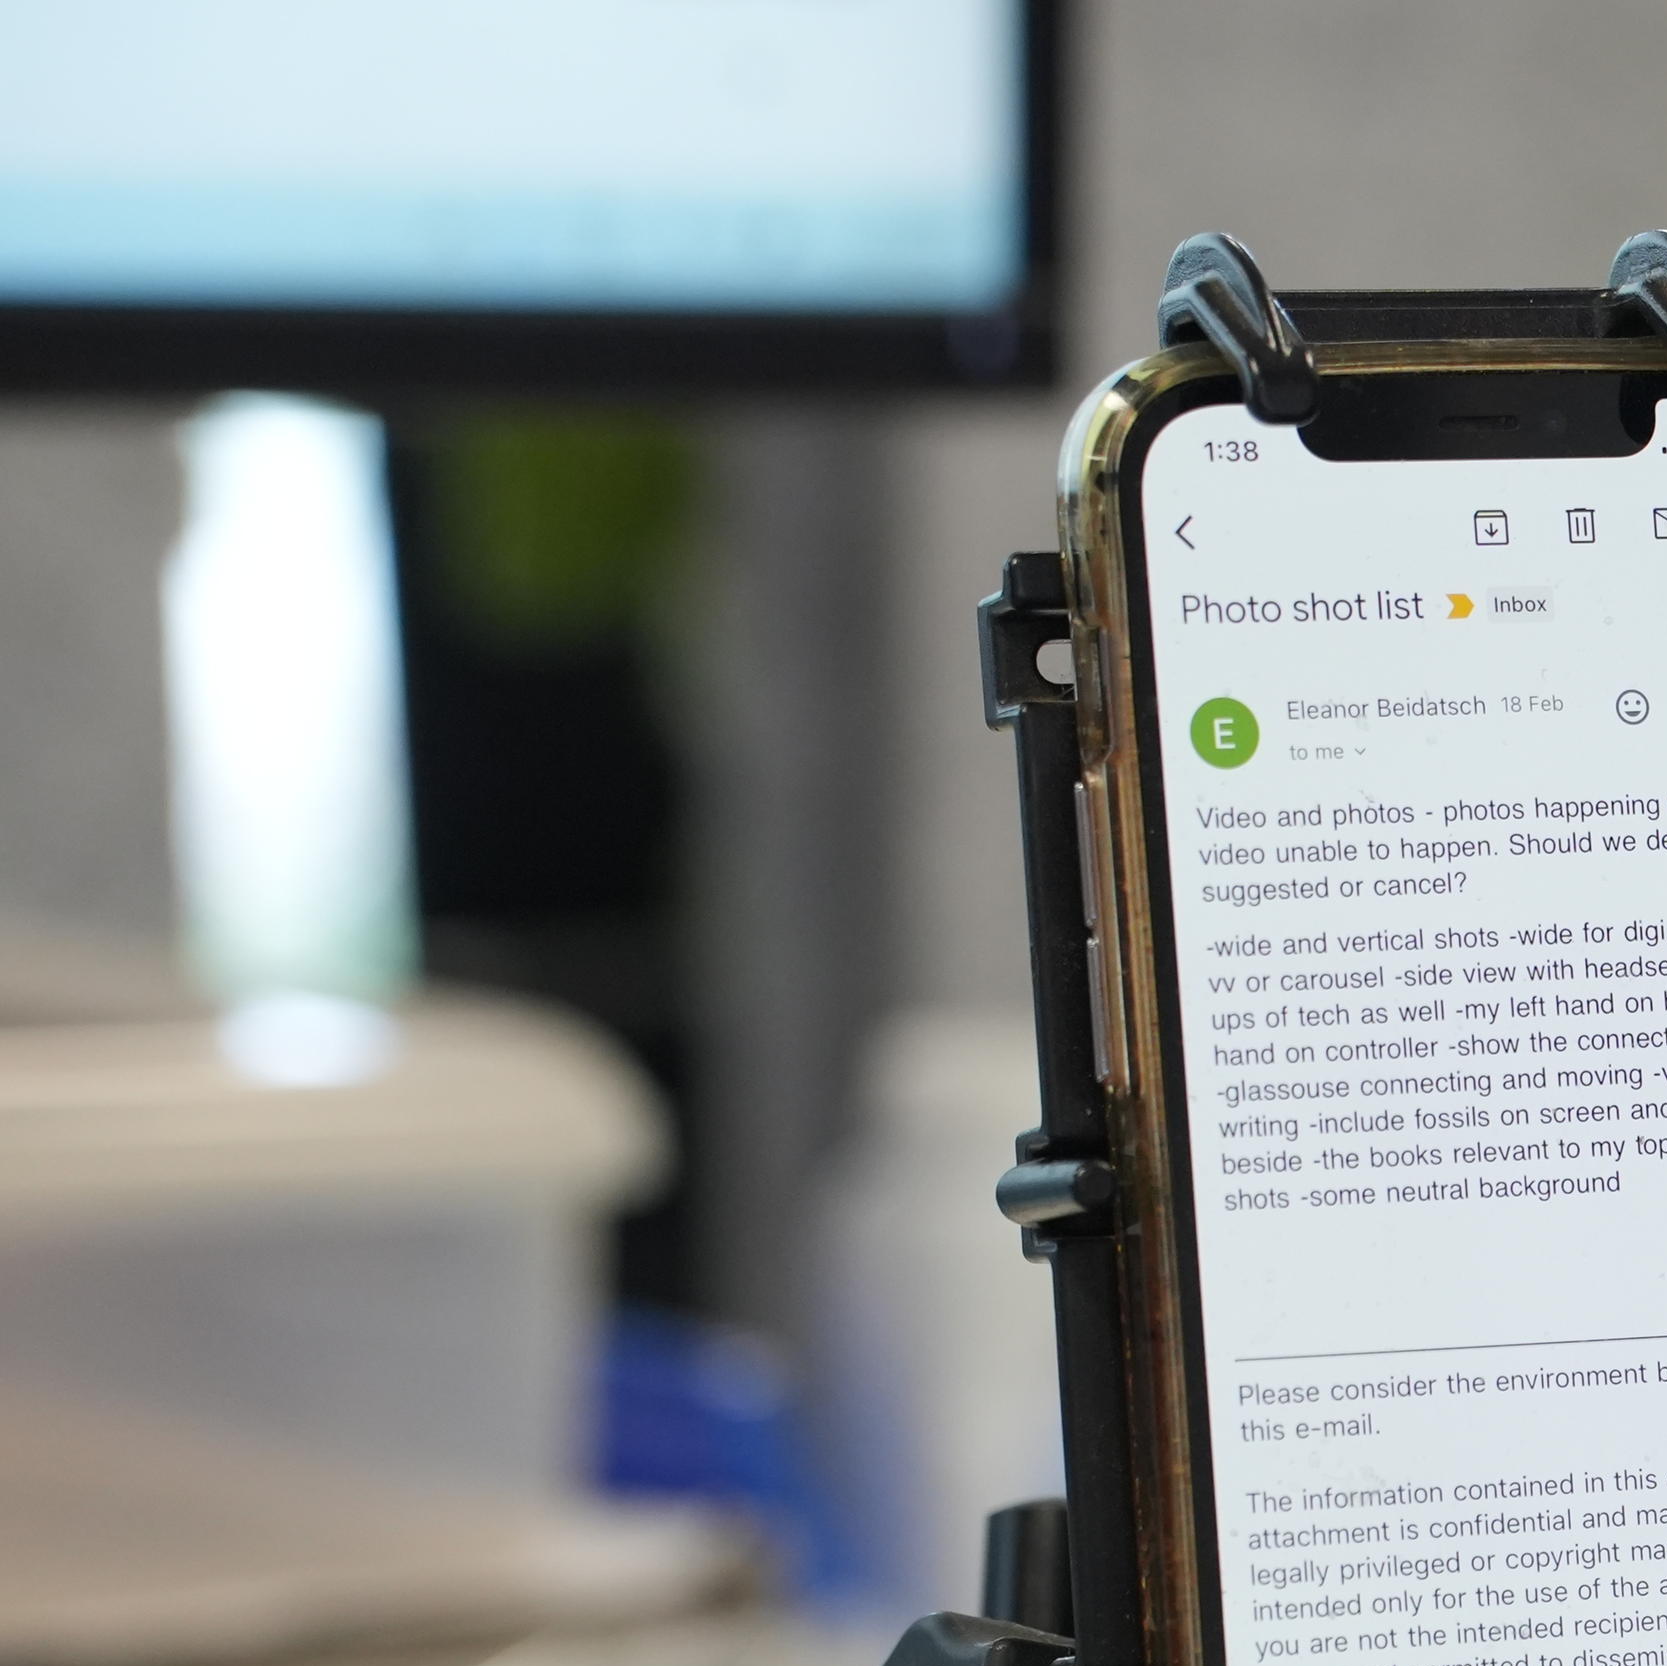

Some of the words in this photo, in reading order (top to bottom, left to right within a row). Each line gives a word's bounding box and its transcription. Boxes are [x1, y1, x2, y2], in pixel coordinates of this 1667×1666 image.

[1203, 440, 1259, 463] 1:38
[1181, 593, 1282, 625] Photo
[1292, 591, 1368, 623] shot
[1376, 589, 1425, 621] list
[1493, 595, 1548, 614] Inbox
[1286, 699, 1370, 721] Eleanor
[1376, 695, 1487, 718] Beidatsch
[1500, 695, 1523, 713] 18
[1528, 694, 1564, 712] Feb
[1212, 717, 1237, 750] E
[1289, 745, 1309, 761] to
[1315, 746, 1344, 760] me
[1195, 806, 1267, 830] Video
[1277, 803, 1323, 828] and
[1332, 800, 1415, 832] photos
[1443, 799, 1525, 828] photos
[1534, 793, 1661, 824] happening
[1198, 842, 1266, 866] video
[1275, 839, 1358, 864] unable
[1366, 839, 1391, 861] to
[1400, 837, 1499, 865] happen.
[1508, 830, 1593, 856] Should
[1601, 834, 1637, 852] we
[1201, 875, 1330, 908] suggested
[1339, 880, 1364, 898] or
[1372, 871, 1468, 897] cancel?
[1206, 933, 1272, 958] -wide
[1282, 931, 1328, 956] and
[1336, 927, 1424, 953] vertical
[1434, 926, 1500, 950] shots
[1508, 922, 1574, 946] -wide
[1581, 921, 1615, 944] for
[1207, 976, 1236, 994] vv
[1245, 975, 1271, 993] or
[1279, 965, 1384, 992] carousel
[1394, 963, 1453, 987] -side
[1461, 961, 1517, 984] view
[1525, 958, 1575, 982] with
[1211, 1012, 1256, 1036] ups
[1265, 1005, 1288, 1029] of
[1297, 1002, 1350, 1027] tech
[1360, 1006, 1389, 1025] as
[1397, 999, 1445, 1023] well
[1455, 1002, 1501, 1026] -my
[1509, 994, 1547, 1019] left
[1555, 991, 1615, 1017] hand
[1624, 995, 1654, 1014] on
[1213, 1041, 1275, 1067] hand
[1284, 1045, 1315, 1064] on
[1325, 1036, 1439, 1063] controller
[1448, 1033, 1520, 1057] -show
[1528, 1030, 1568, 1054] the
[1216, 1079, 1350, 1109] -glassouse
[1359, 1069, 1492, 1098] connecting
[1502, 1066, 1547, 1091] and
[1557, 1063, 1643, 1091] moving
[1218, 1114, 1299, 1143] writing
[1309, 1109, 1405, 1135] -include
[1413, 1105, 1491, 1130] fossils
[1499, 1108, 1530, 1127] on
[1539, 1104, 1621, 1125] screen
[1221, 1149, 1303, 1176] beside
[1313, 1147, 1360, 1171] -the
[1369, 1143, 1443, 1169] books
[1453, 1139, 1550, 1164] relevant
[1557, 1138, 1581, 1160] to
[1590, 1139, 1626, 1163] my
[1224, 1187, 1290, 1212] shots
[1300, 1187, 1376, 1208] -some
[1386, 1176, 1469, 1203] neutral
[1478, 1169, 1621, 1202] background
[1238, 1383, 1320, 1406] Please
[1330, 1374, 1438, 1402] consider
[1445, 1371, 1486, 1395] the
[1495, 1363, 1648, 1392] environment
[1240, 1418, 1286, 1443] this
[1295, 1412, 1381, 1440] e-mail.
[1245, 1490, 1293, 1514] The
[1302, 1481, 1444, 1511] information
[1453, 1471, 1575, 1502] contained
[1584, 1471, 1605, 1494] in
[1613, 1467, 1658, 1492] this
[1248, 1521, 1391, 1551] attachment
[1399, 1518, 1420, 1541] is
[1428, 1507, 1572, 1539] confidential
[1582, 1504, 1627, 1530] and
[1250, 1559, 1330, 1590] legally
[1340, 1550, 1461, 1586] privileged
[1470, 1553, 1496, 1572] or
[1505, 1541, 1621, 1573] copyright
[1252, 1592, 1362, 1622] intended
[1371, 1589, 1423, 1617] only
[1431, 1587, 1467, 1611] for
[1474, 1584, 1515, 1608] the
[1524, 1585, 1569, 1605] use
[1577, 1577, 1601, 1601] of
[1610, 1575, 1650, 1599] the
